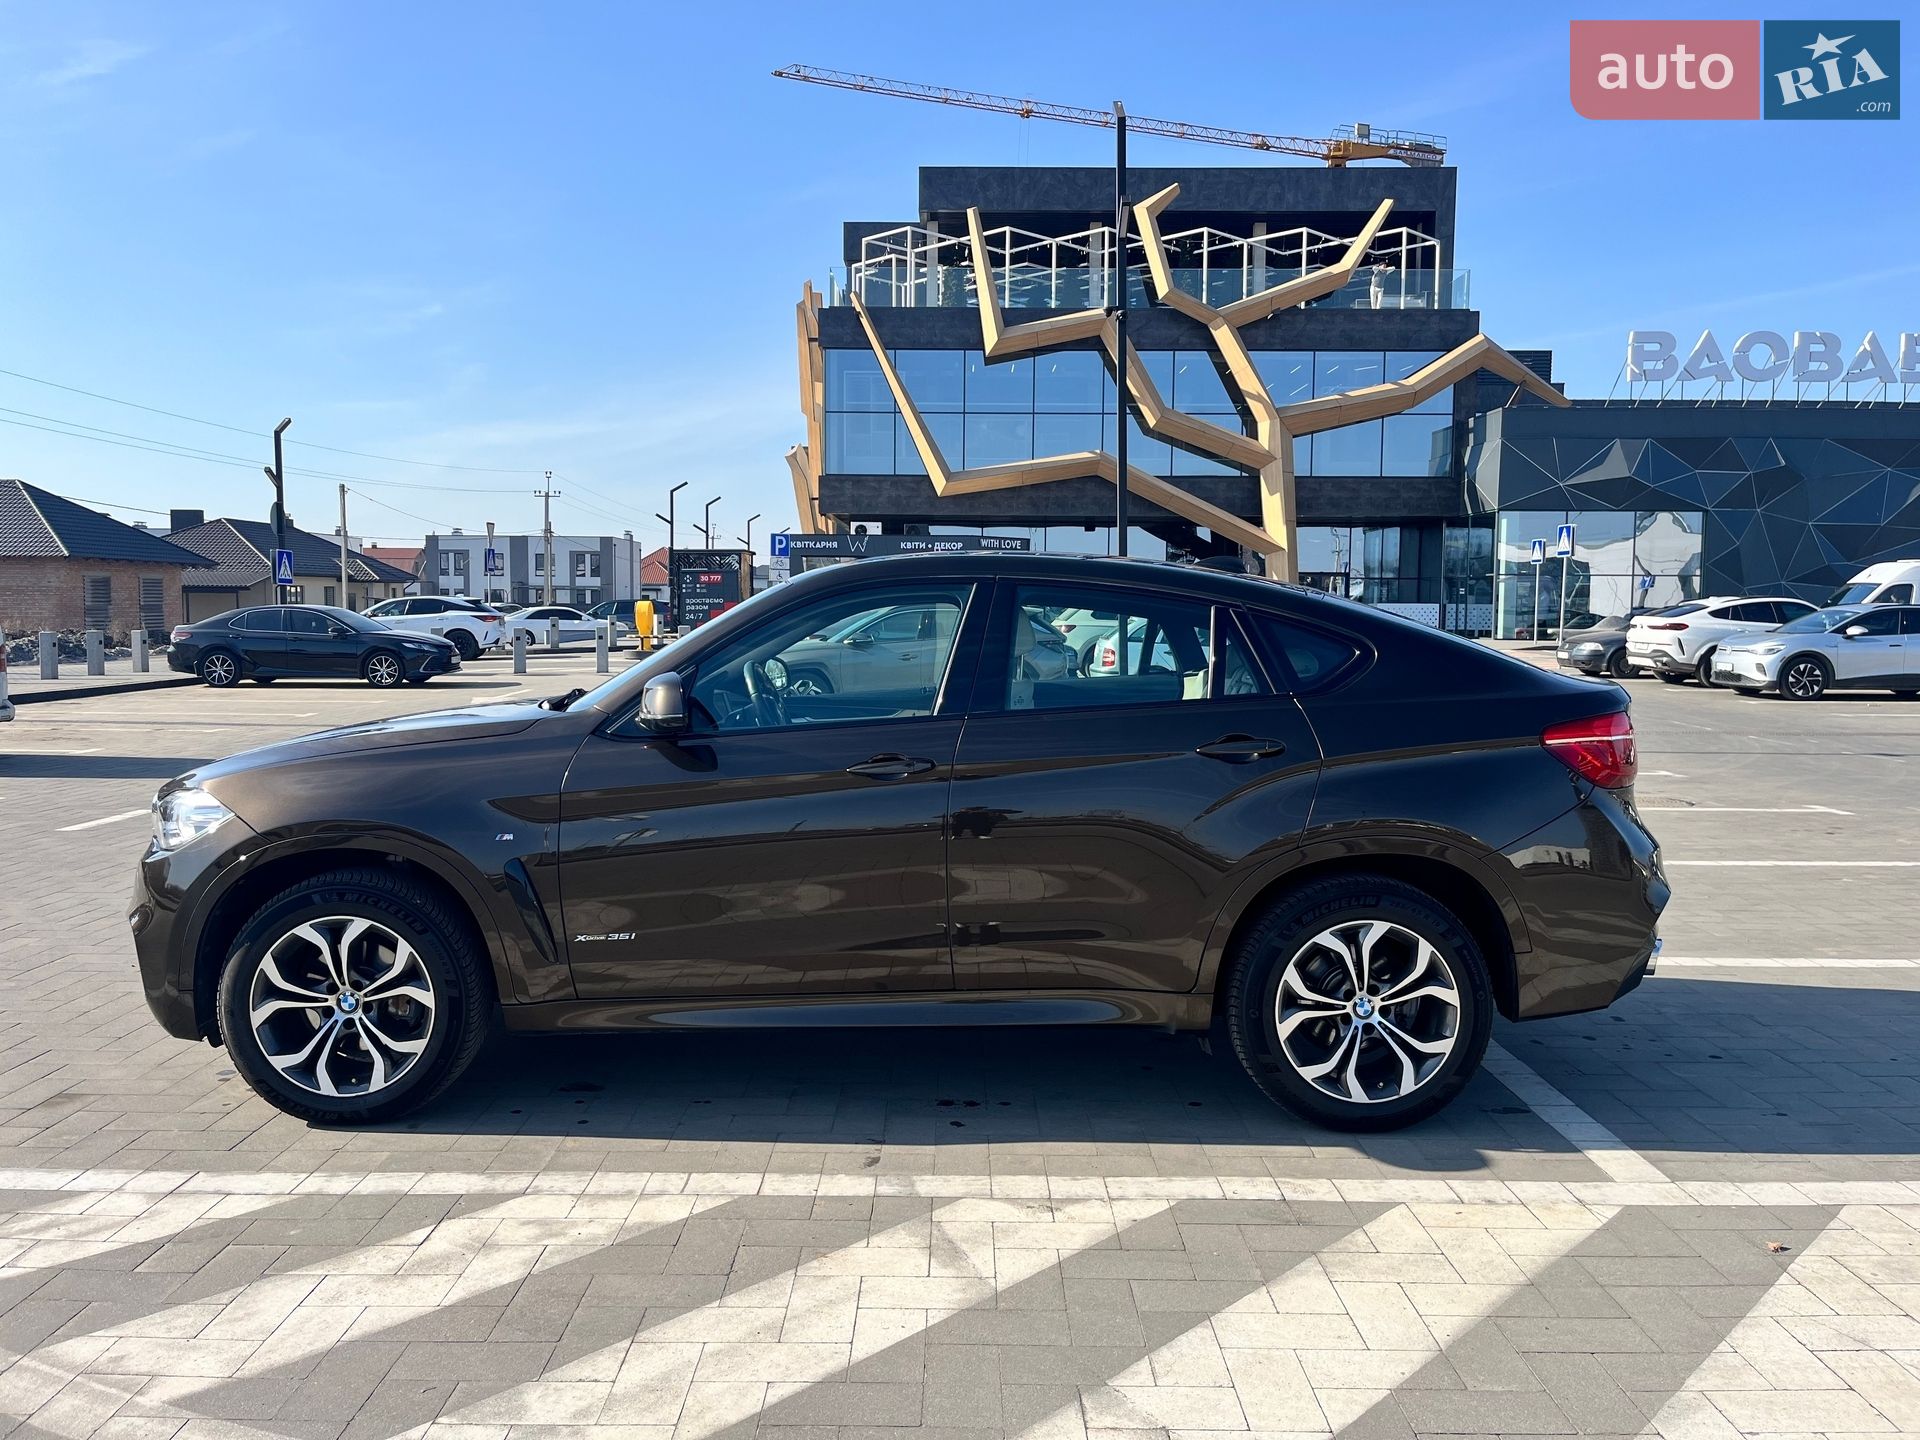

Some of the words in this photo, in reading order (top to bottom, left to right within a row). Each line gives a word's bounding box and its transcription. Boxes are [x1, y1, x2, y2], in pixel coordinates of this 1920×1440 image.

[775, 536, 787, 555] P
[790, 541, 838, 549] КВІТКАРНЯ
[900, 541, 926, 549] КВІТИ
[934, 542, 964, 552] ДЕКОР
[981, 539, 1000, 548] WITH
[1001, 540, 1022, 549] LOVE
[341, 892, 429, 936] MICHELIN
[1302, 896, 1378, 924] MICHELIN
